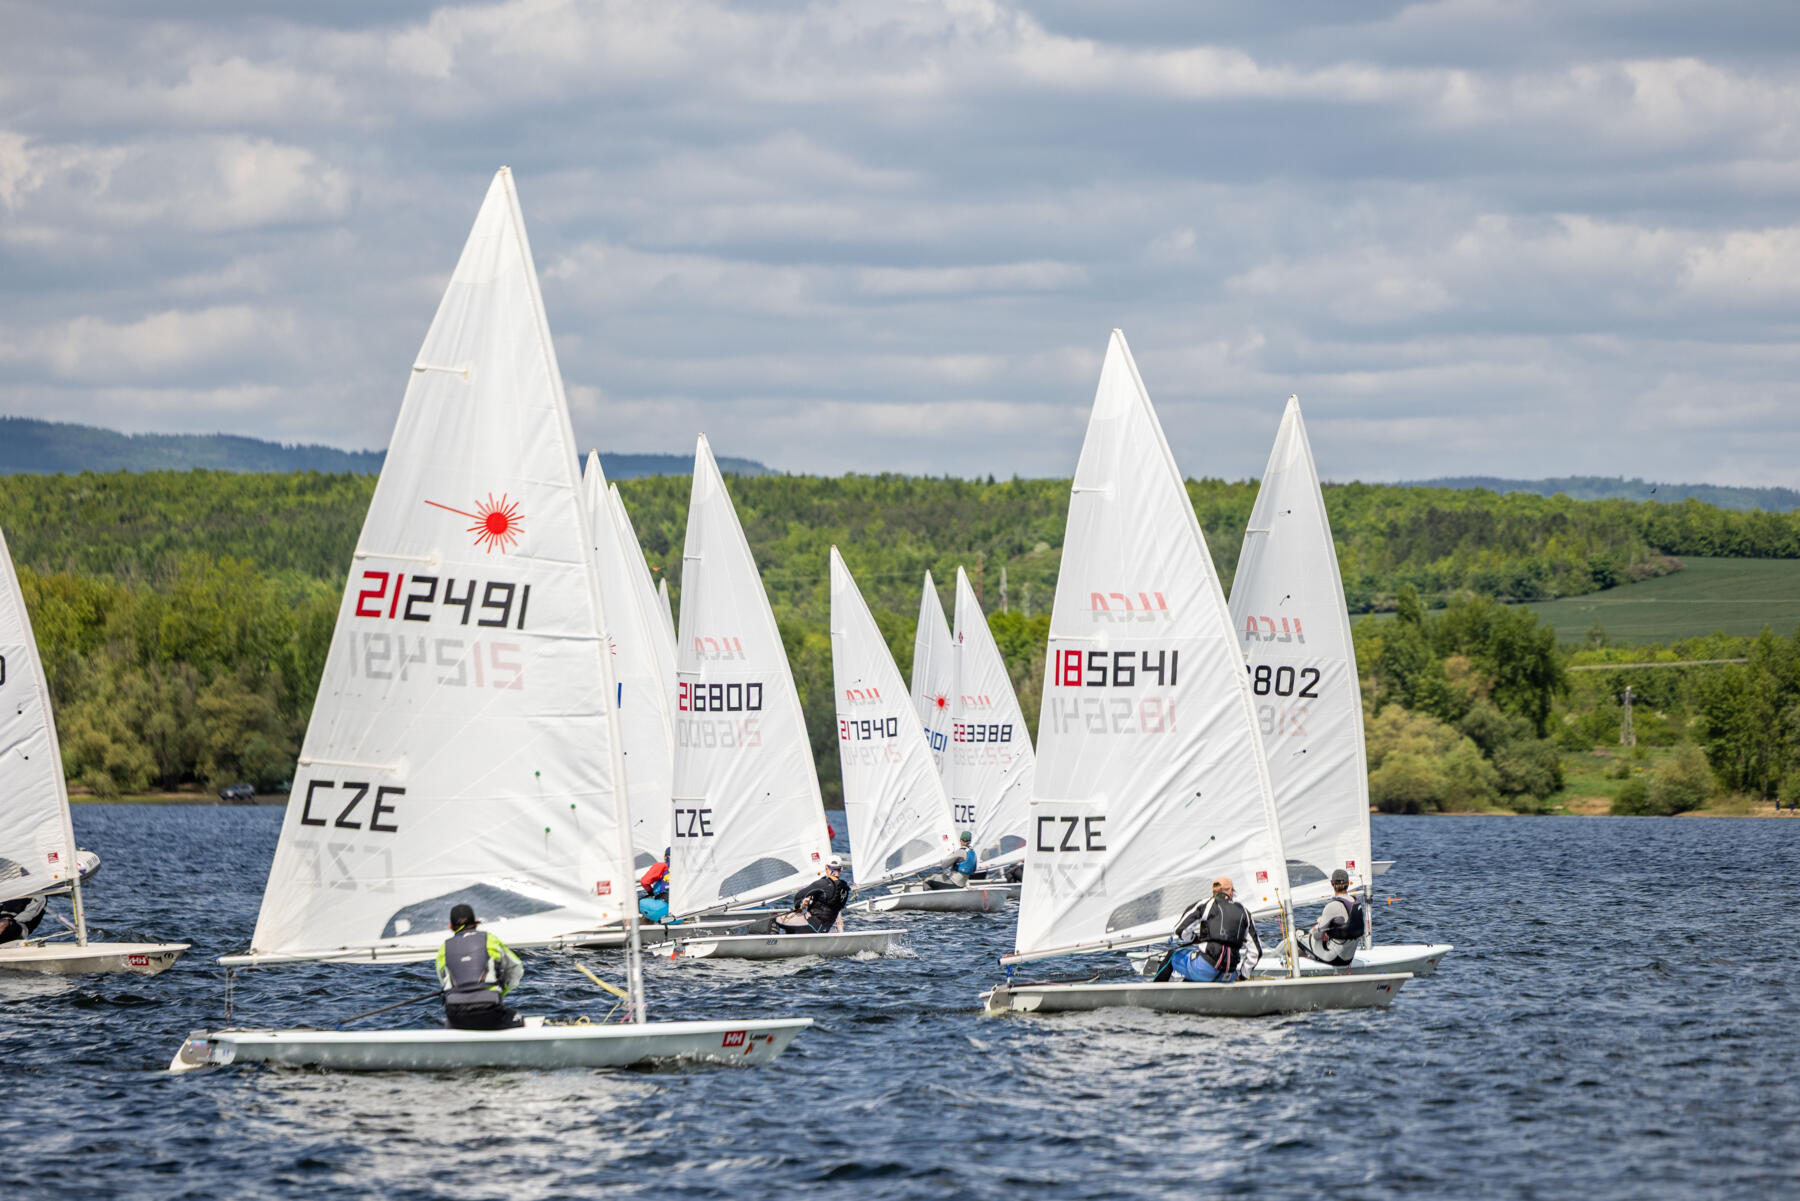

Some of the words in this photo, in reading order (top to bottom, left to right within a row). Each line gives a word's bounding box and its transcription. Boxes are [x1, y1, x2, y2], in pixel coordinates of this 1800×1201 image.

[355, 571, 531, 630] 212491
[1055, 650, 1179, 687] 185641
[679, 682, 763, 711] 216800
[840, 717, 898, 741] 217940
[953, 723, 1013, 742] 223388
[301, 780, 406, 832] CZE
[954, 805, 976, 822] CZE
[675, 809, 714, 837] CZE
[1037, 816, 1107, 852] CZE
[725, 1033, 743, 1045] HH
